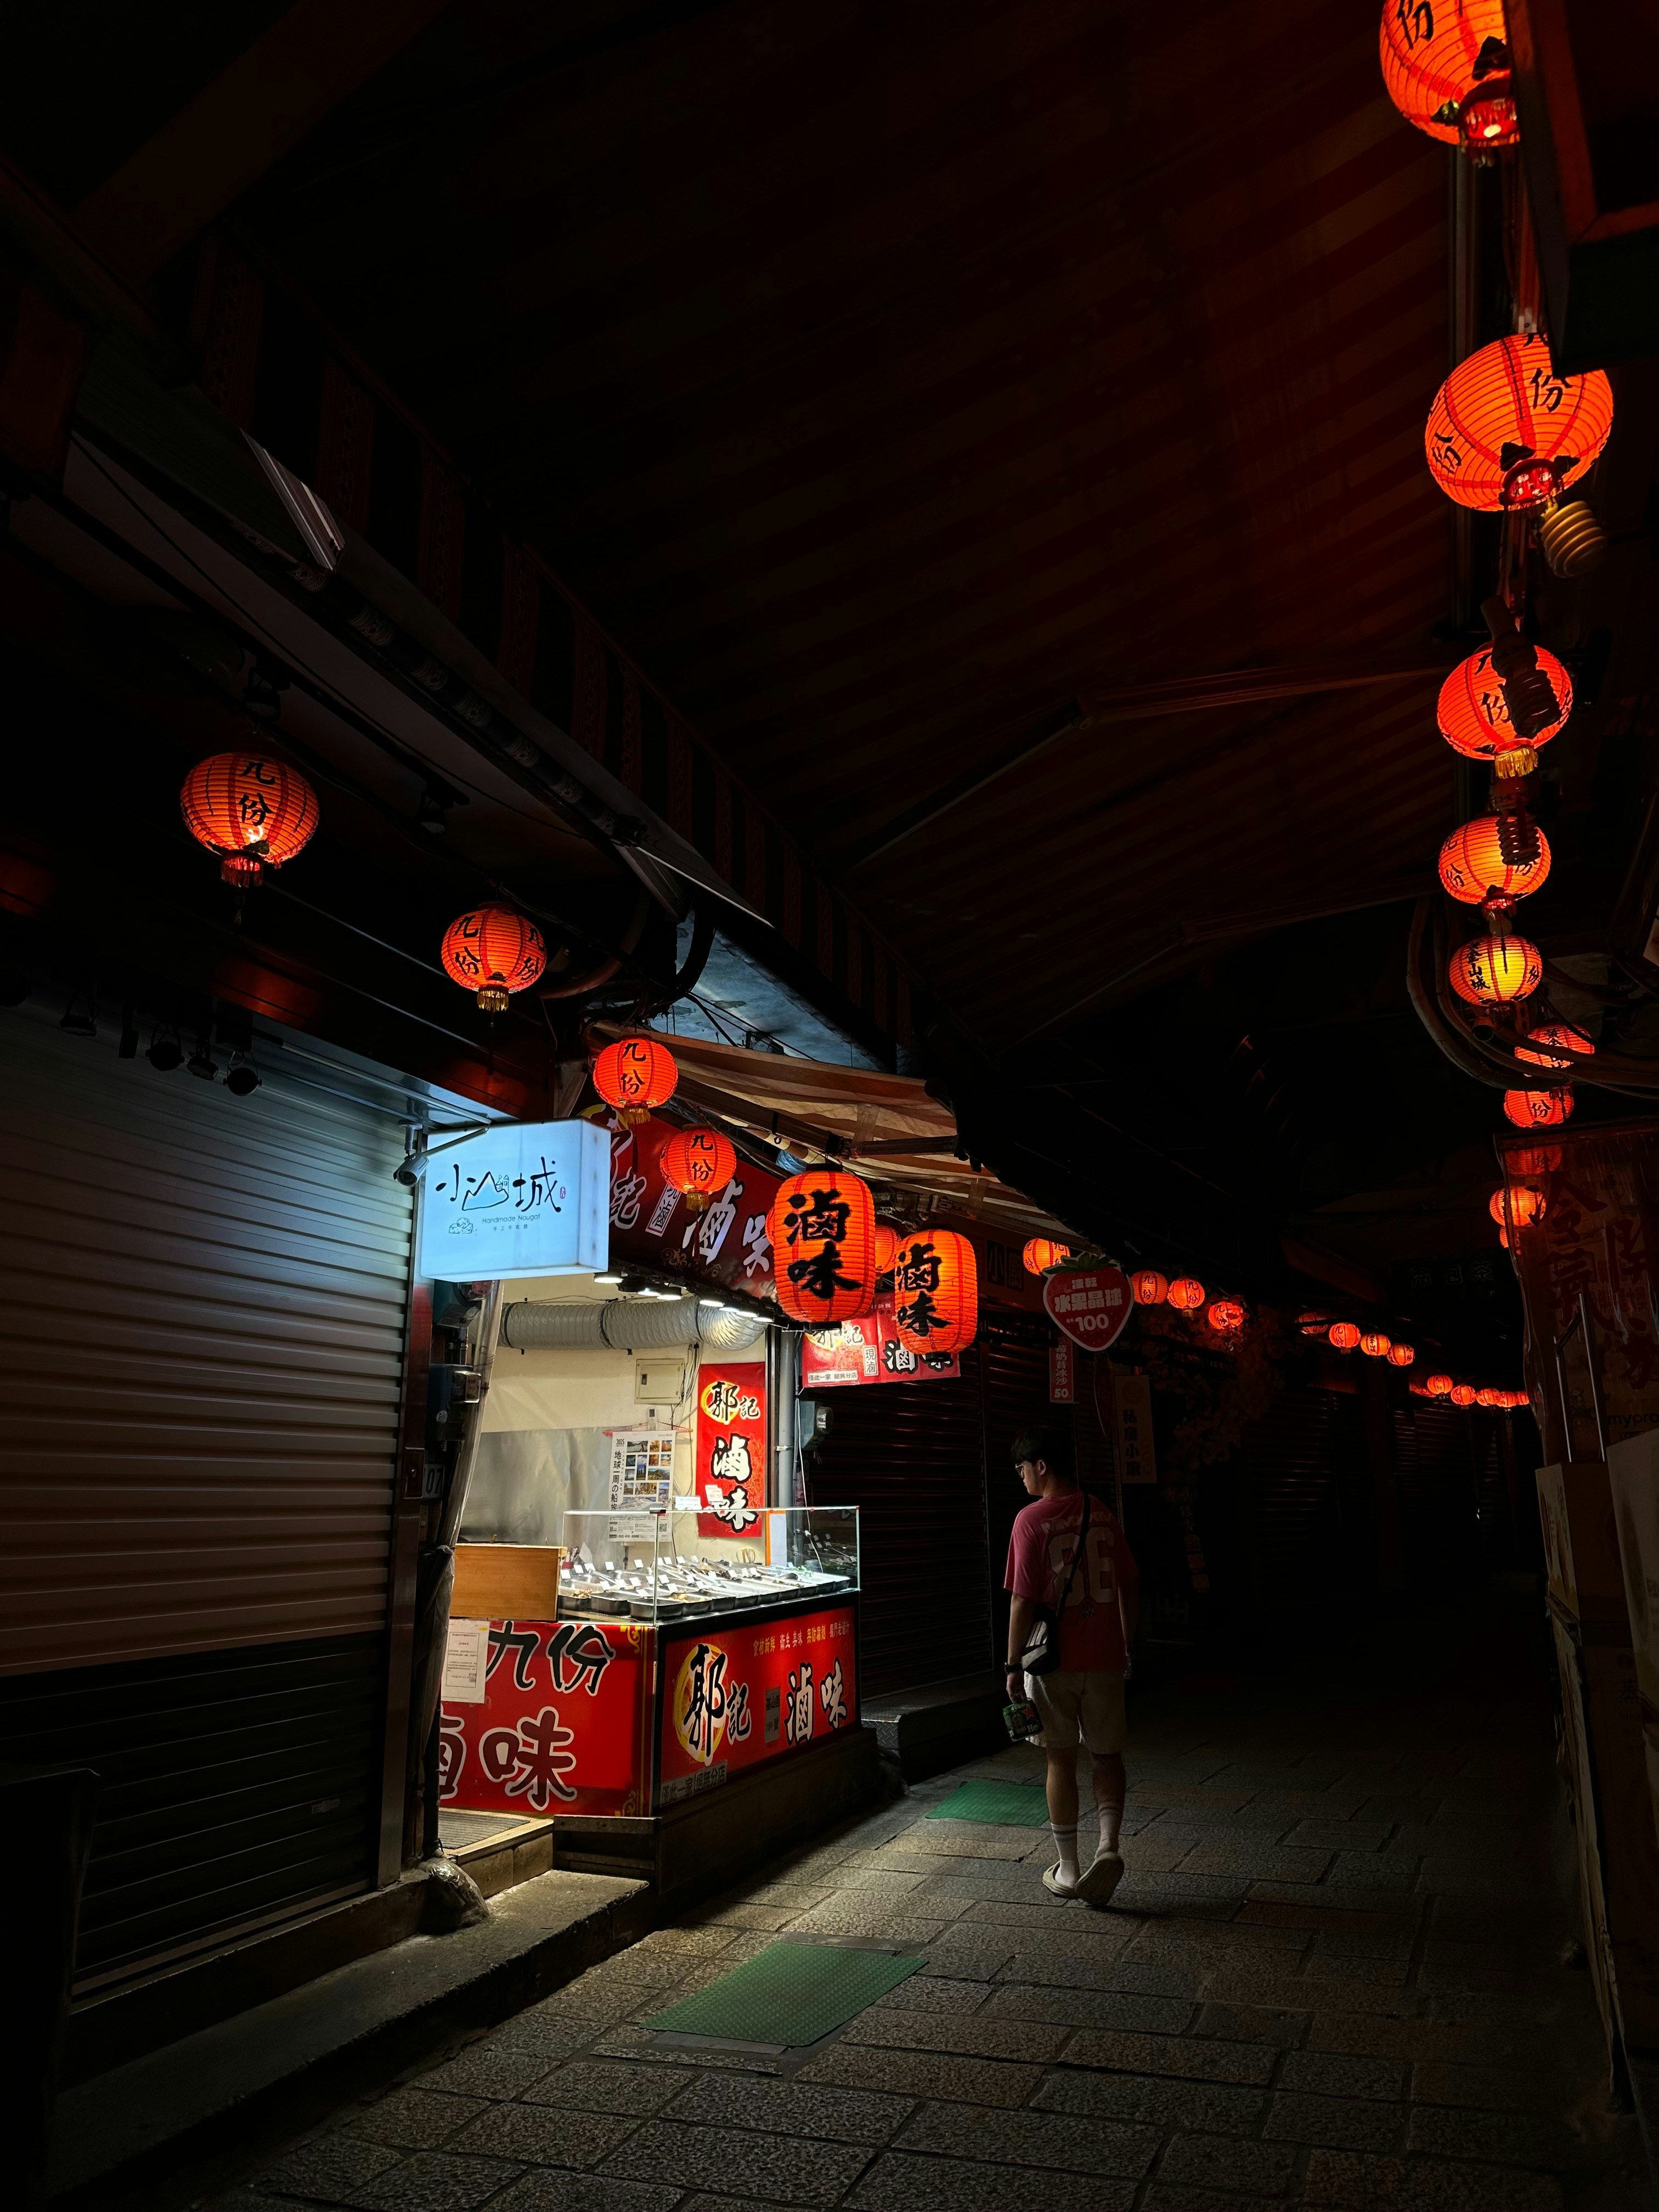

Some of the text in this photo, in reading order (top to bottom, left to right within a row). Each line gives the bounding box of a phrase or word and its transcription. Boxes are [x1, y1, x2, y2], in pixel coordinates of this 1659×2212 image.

[238, 761, 276, 827] 九份
[452, 915, 482, 976] 九份
[620, 1042, 647, 1096] 九份
[691, 1134, 715, 1182] 九份
[482, 1213, 540, 1224] Handmade Nougat
[783, 1188, 863, 1300] 滷味
[895, 1243, 955, 1338] 滷味
[1054, 1288, 1122, 1313] 水果晶球
[1143, 1275, 1154, 1300] 九份
[1187, 1281, 1199, 1304] 九份
[1075, 1314, 1109, 1332] 100
[865, 1348, 876, 1374] 現滷
[708, 1381, 760, 1422] 郭記
[1054, 1388, 1069, 1399] 50
[710, 1432, 759, 1533] 滷味
[1048, 1526, 1116, 1609] 86
[485, 1620, 617, 1696] 九份
[682, 1643, 848, 1766] 郭記 滷味
